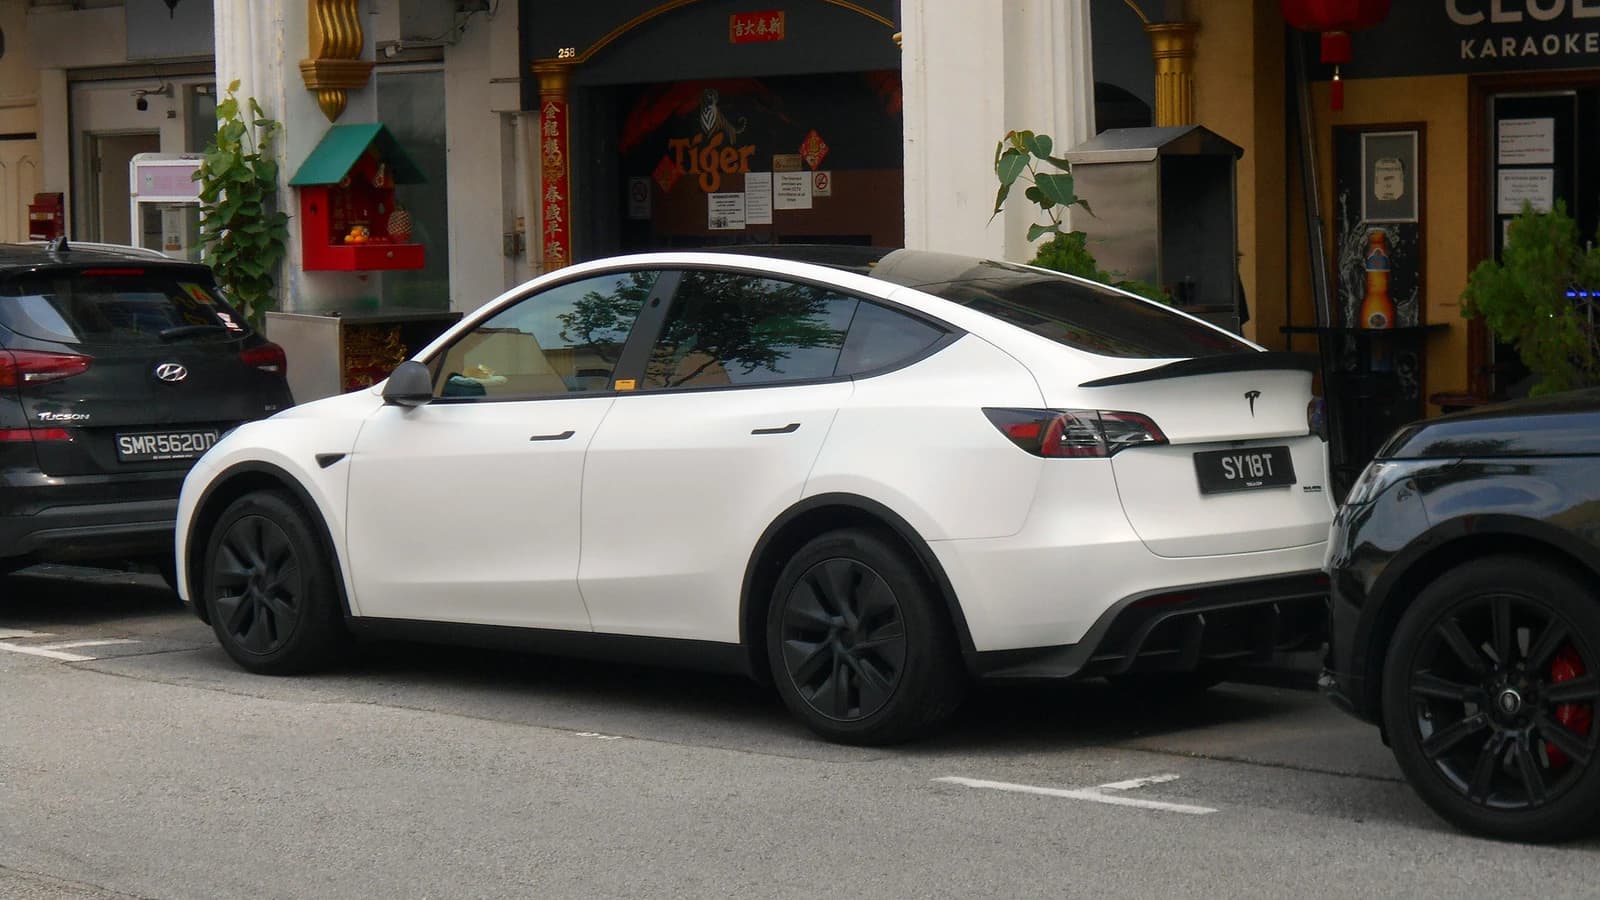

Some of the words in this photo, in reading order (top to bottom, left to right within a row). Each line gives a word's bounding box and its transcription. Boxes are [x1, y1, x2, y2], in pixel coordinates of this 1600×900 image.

[558, 47, 575, 59] 258
[1460, 32, 1600, 59] KARAOKE
[668, 132, 756, 193] Tiger
[1221, 453, 1273, 480] SY18T
